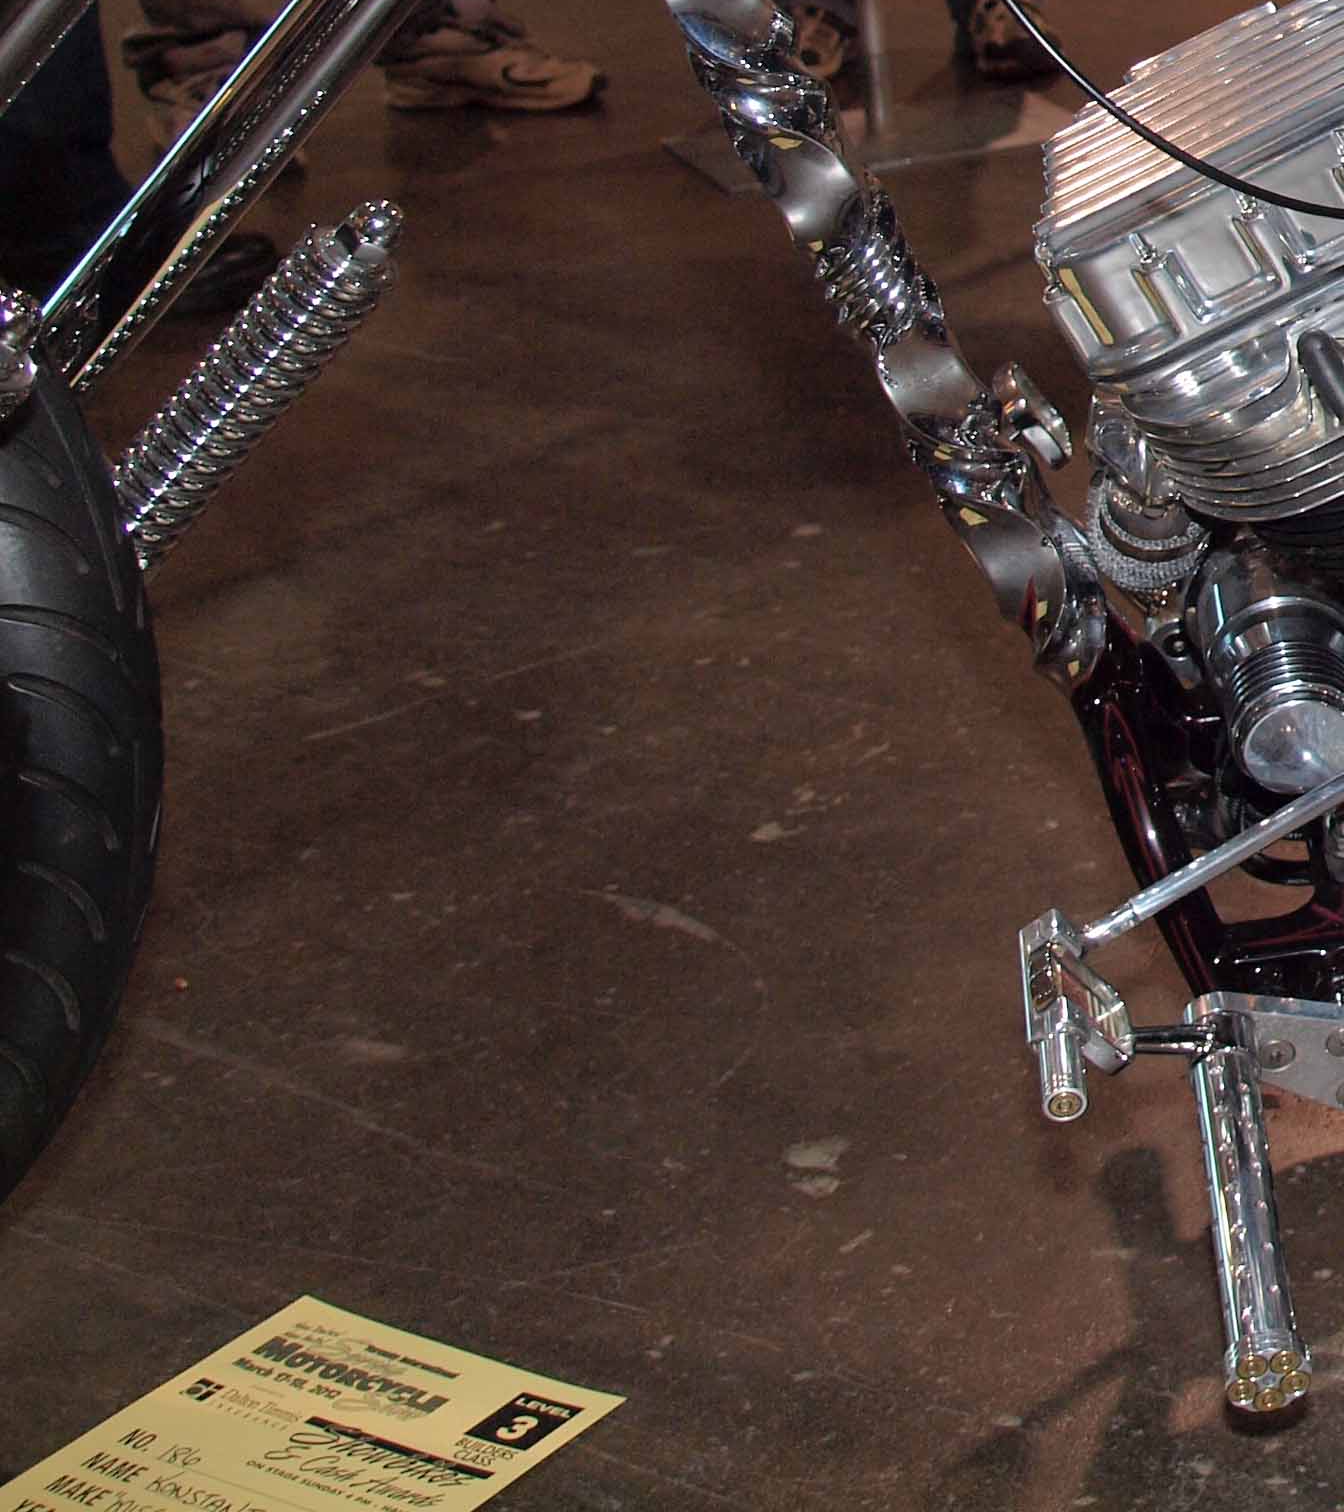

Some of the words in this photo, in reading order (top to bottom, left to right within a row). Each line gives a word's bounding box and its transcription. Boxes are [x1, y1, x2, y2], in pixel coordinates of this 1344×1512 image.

[515, 1397, 570, 1418] LEVEL
[496, 1415, 539, 1440] 3
[118, 1428, 157, 1452] NO.
[455, 1438, 517, 1460] BUILDERS
[81, 1452, 149, 1483] NAME
[454, 1450, 495, 1467] CLASS
[44, 1475, 112, 1506] MAKE
